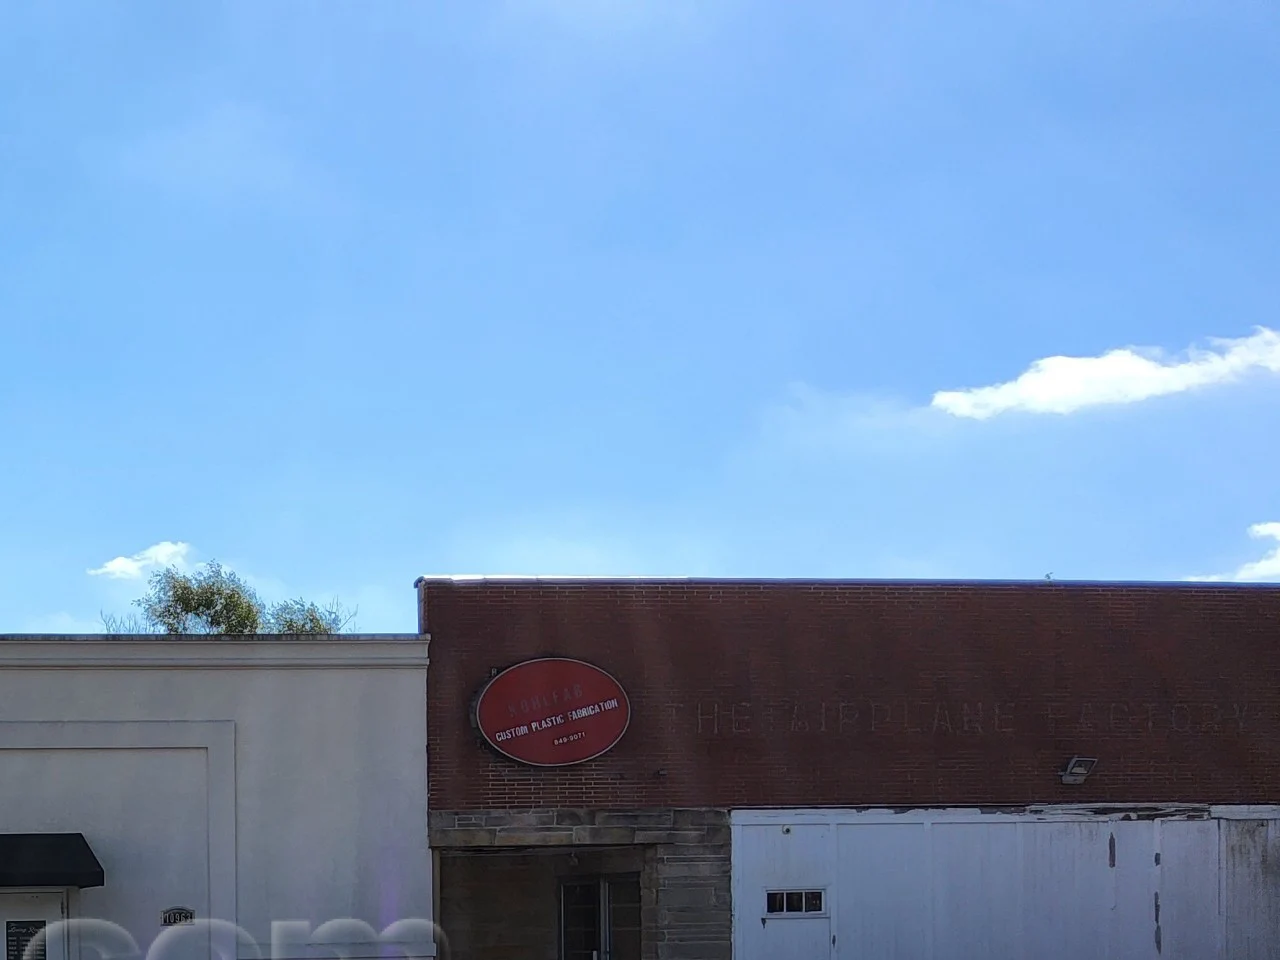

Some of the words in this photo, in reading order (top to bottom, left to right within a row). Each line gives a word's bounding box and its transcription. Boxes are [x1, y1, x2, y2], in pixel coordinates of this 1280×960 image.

[495, 725, 529, 743] CUSTOM
[531, 714, 565, 732] PLASTIC
[568, 698, 619, 722] FABRICATION
[164, 912, 191, 924] 10963
